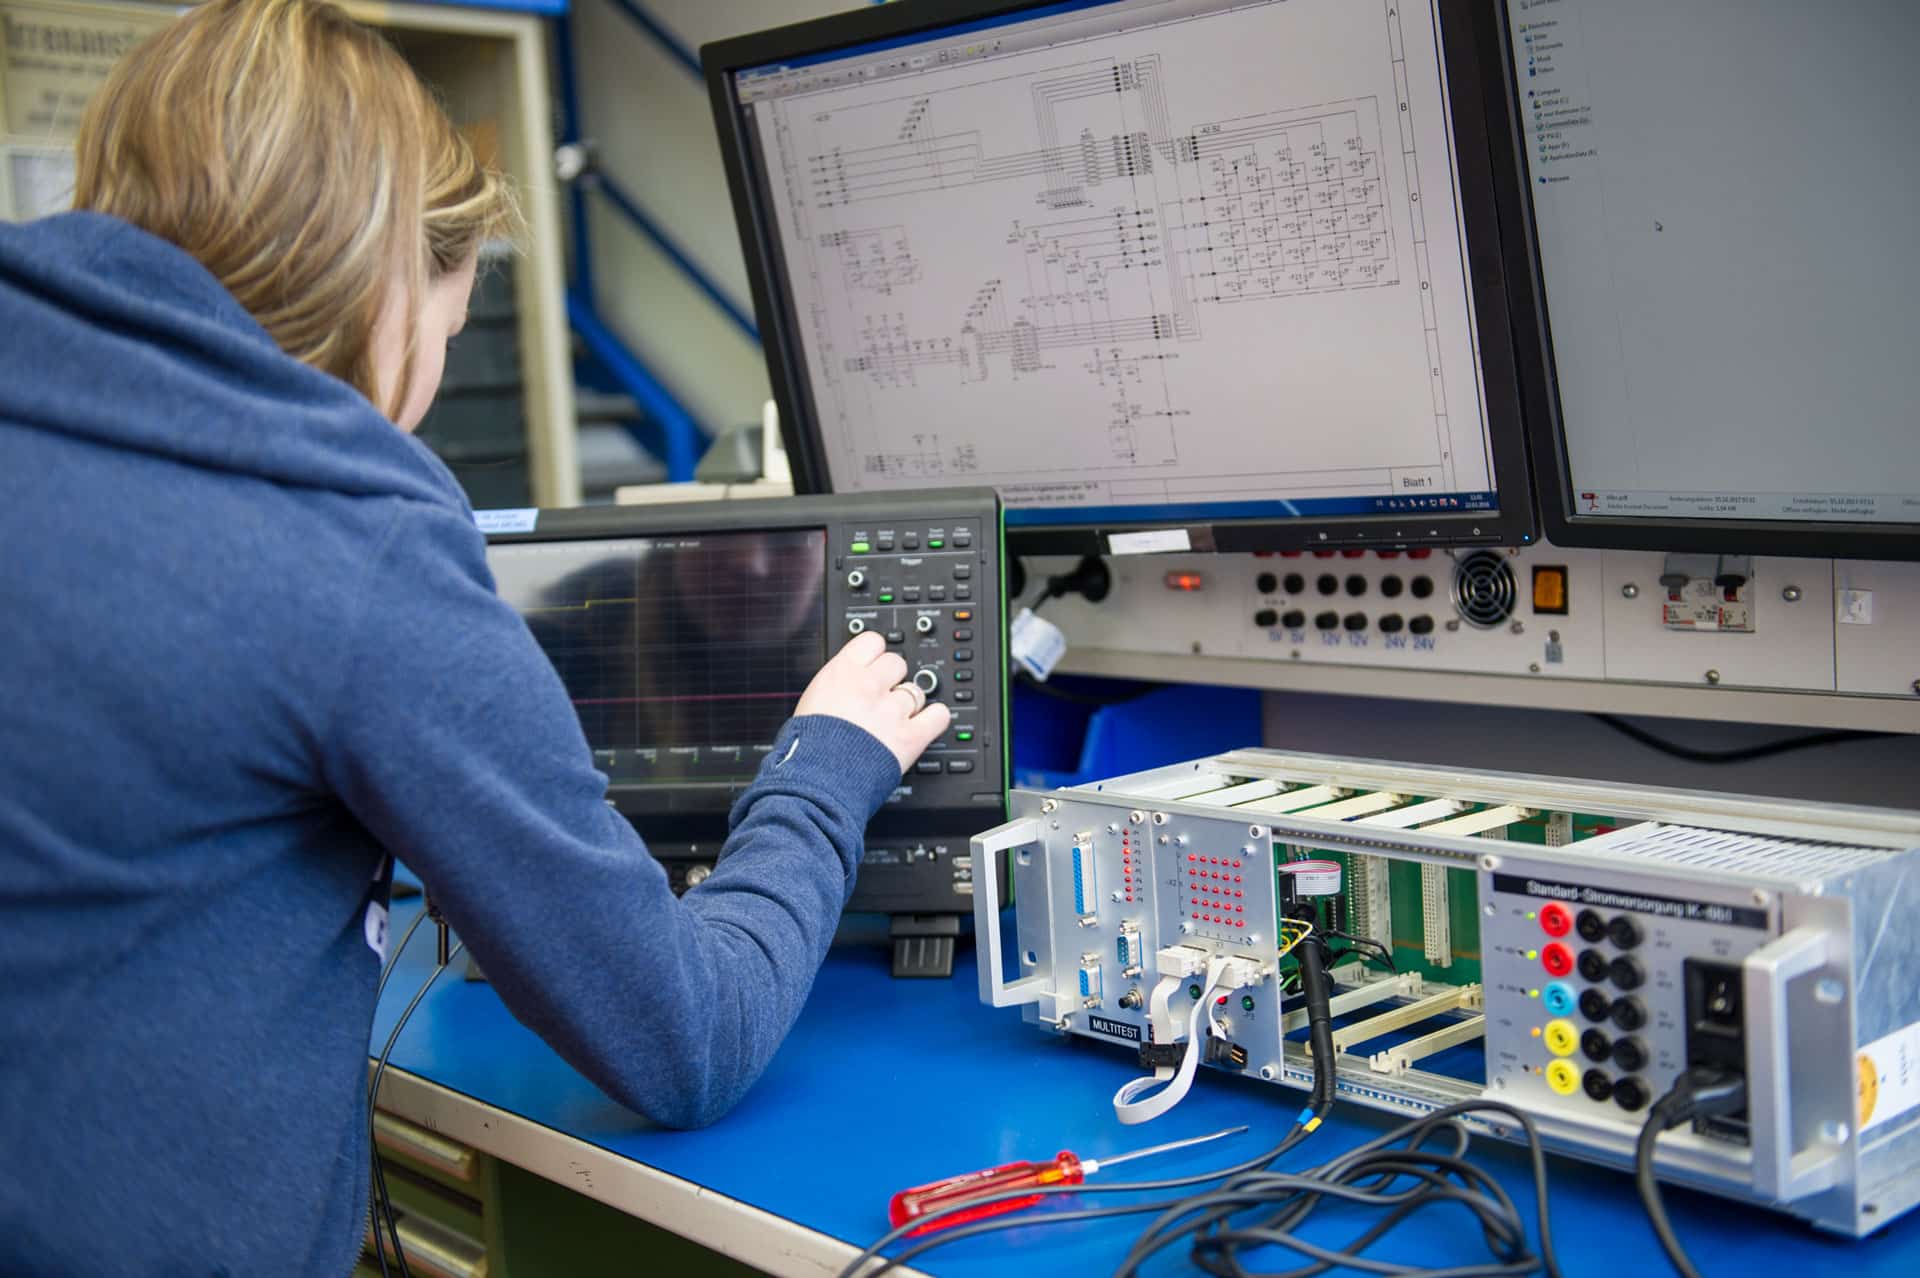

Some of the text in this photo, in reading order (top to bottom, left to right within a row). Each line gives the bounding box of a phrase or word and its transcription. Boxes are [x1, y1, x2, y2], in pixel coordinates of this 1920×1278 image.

[1388, 8, 1396, 17] A
[1400, 102, 1408, 112] B
[1411, 193, 1419, 202] C
[1421, 281, 1429, 291] D
[1433, 367, 1440, 377] E
[1403, 478, 1425, 487] Blatt
[1385, 635, 1406, 649] 24V
[1413, 636, 1436, 651] 24V
[1092, 1017, 1137, 1039] MULTITEST
